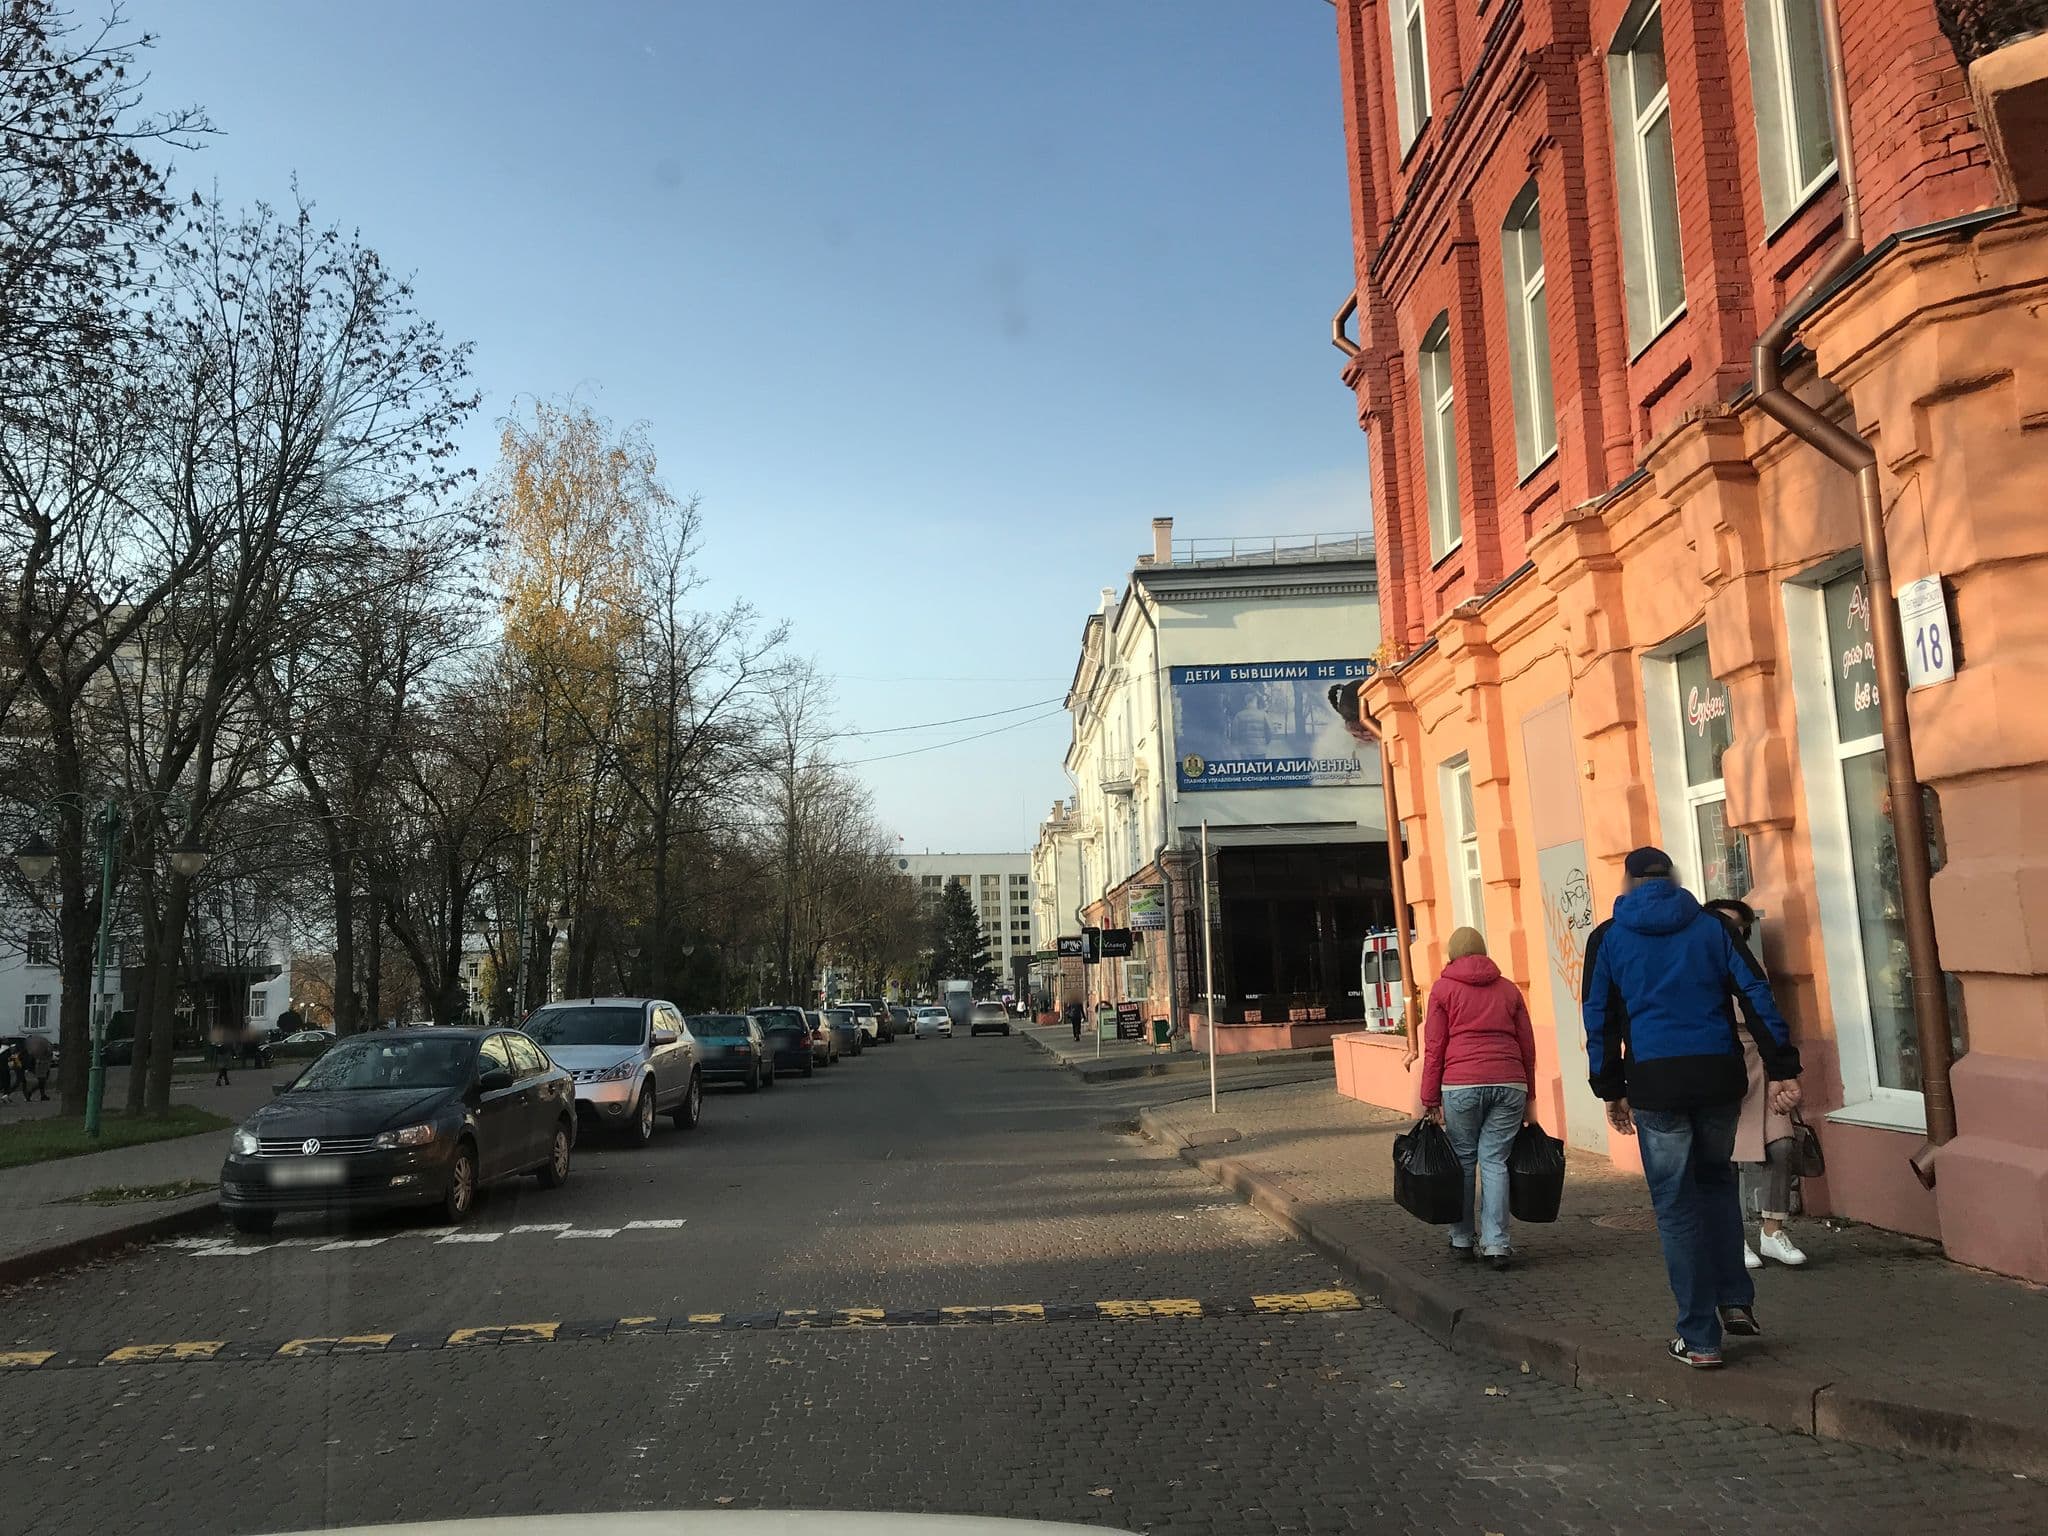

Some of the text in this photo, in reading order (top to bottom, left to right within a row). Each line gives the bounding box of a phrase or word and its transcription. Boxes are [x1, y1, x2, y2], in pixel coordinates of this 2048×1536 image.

[1916, 623, 1943, 673] 18
[1185, 670, 1220, 684] ДЕТИ
[1230, 667, 1308, 680] БЫВШИМИ
[1318, 665, 1336, 677] НЕ
[1208, 759, 1361, 776] ЗАПЛАТИ АЛИМЕНТЫ!
